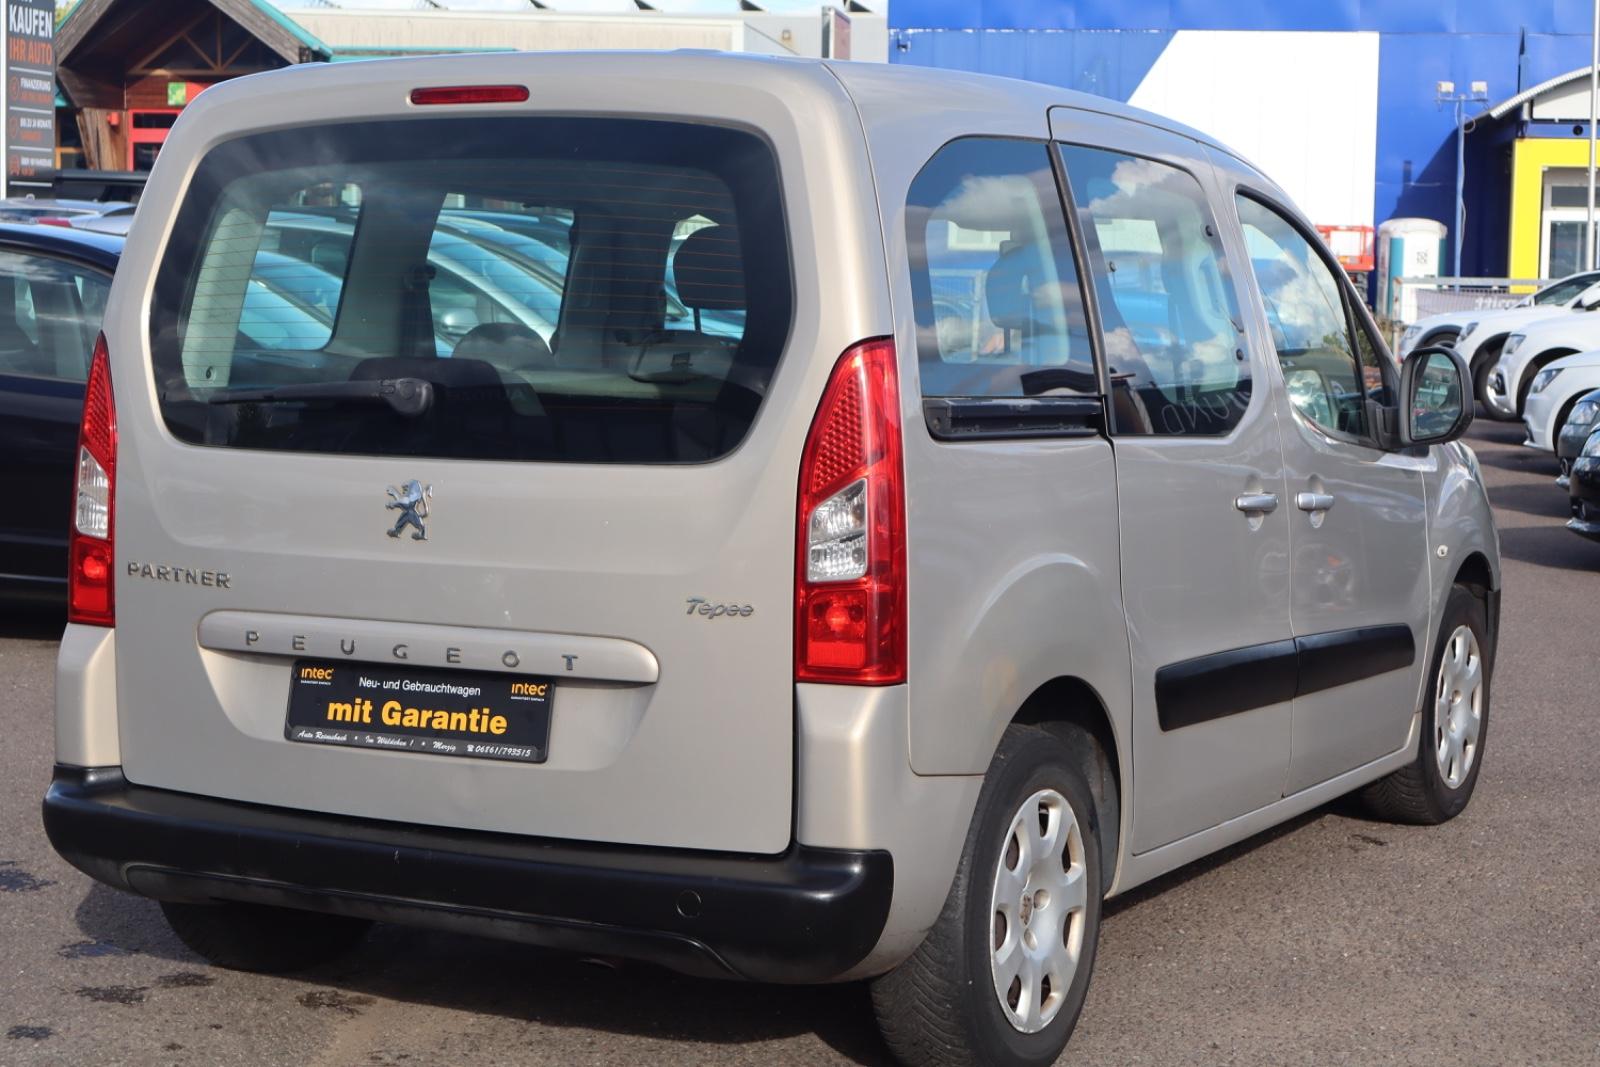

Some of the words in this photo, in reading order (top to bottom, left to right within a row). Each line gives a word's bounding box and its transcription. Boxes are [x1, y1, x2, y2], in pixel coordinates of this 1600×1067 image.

[9, 4, 53, 39] KAUFEN
[9, 36, 26, 62] IHR
[28, 40, 53, 65] AUTO
[127, 560, 232, 589] PARTNER
[685, 597, 755, 620] Tepee
[245, 630, 579, 672] PEUGEOT
[301, 667, 334, 680] intec
[359, 677, 381, 688] Neu-
[383, 680, 400, 690] und
[402, 680, 481, 697] Gebrauchtwagen
[511, 682, 547, 697] intec
[327, 698, 374, 724] mit
[381, 700, 508, 735] Garantie
[432, 741, 457, 752] Merzig
